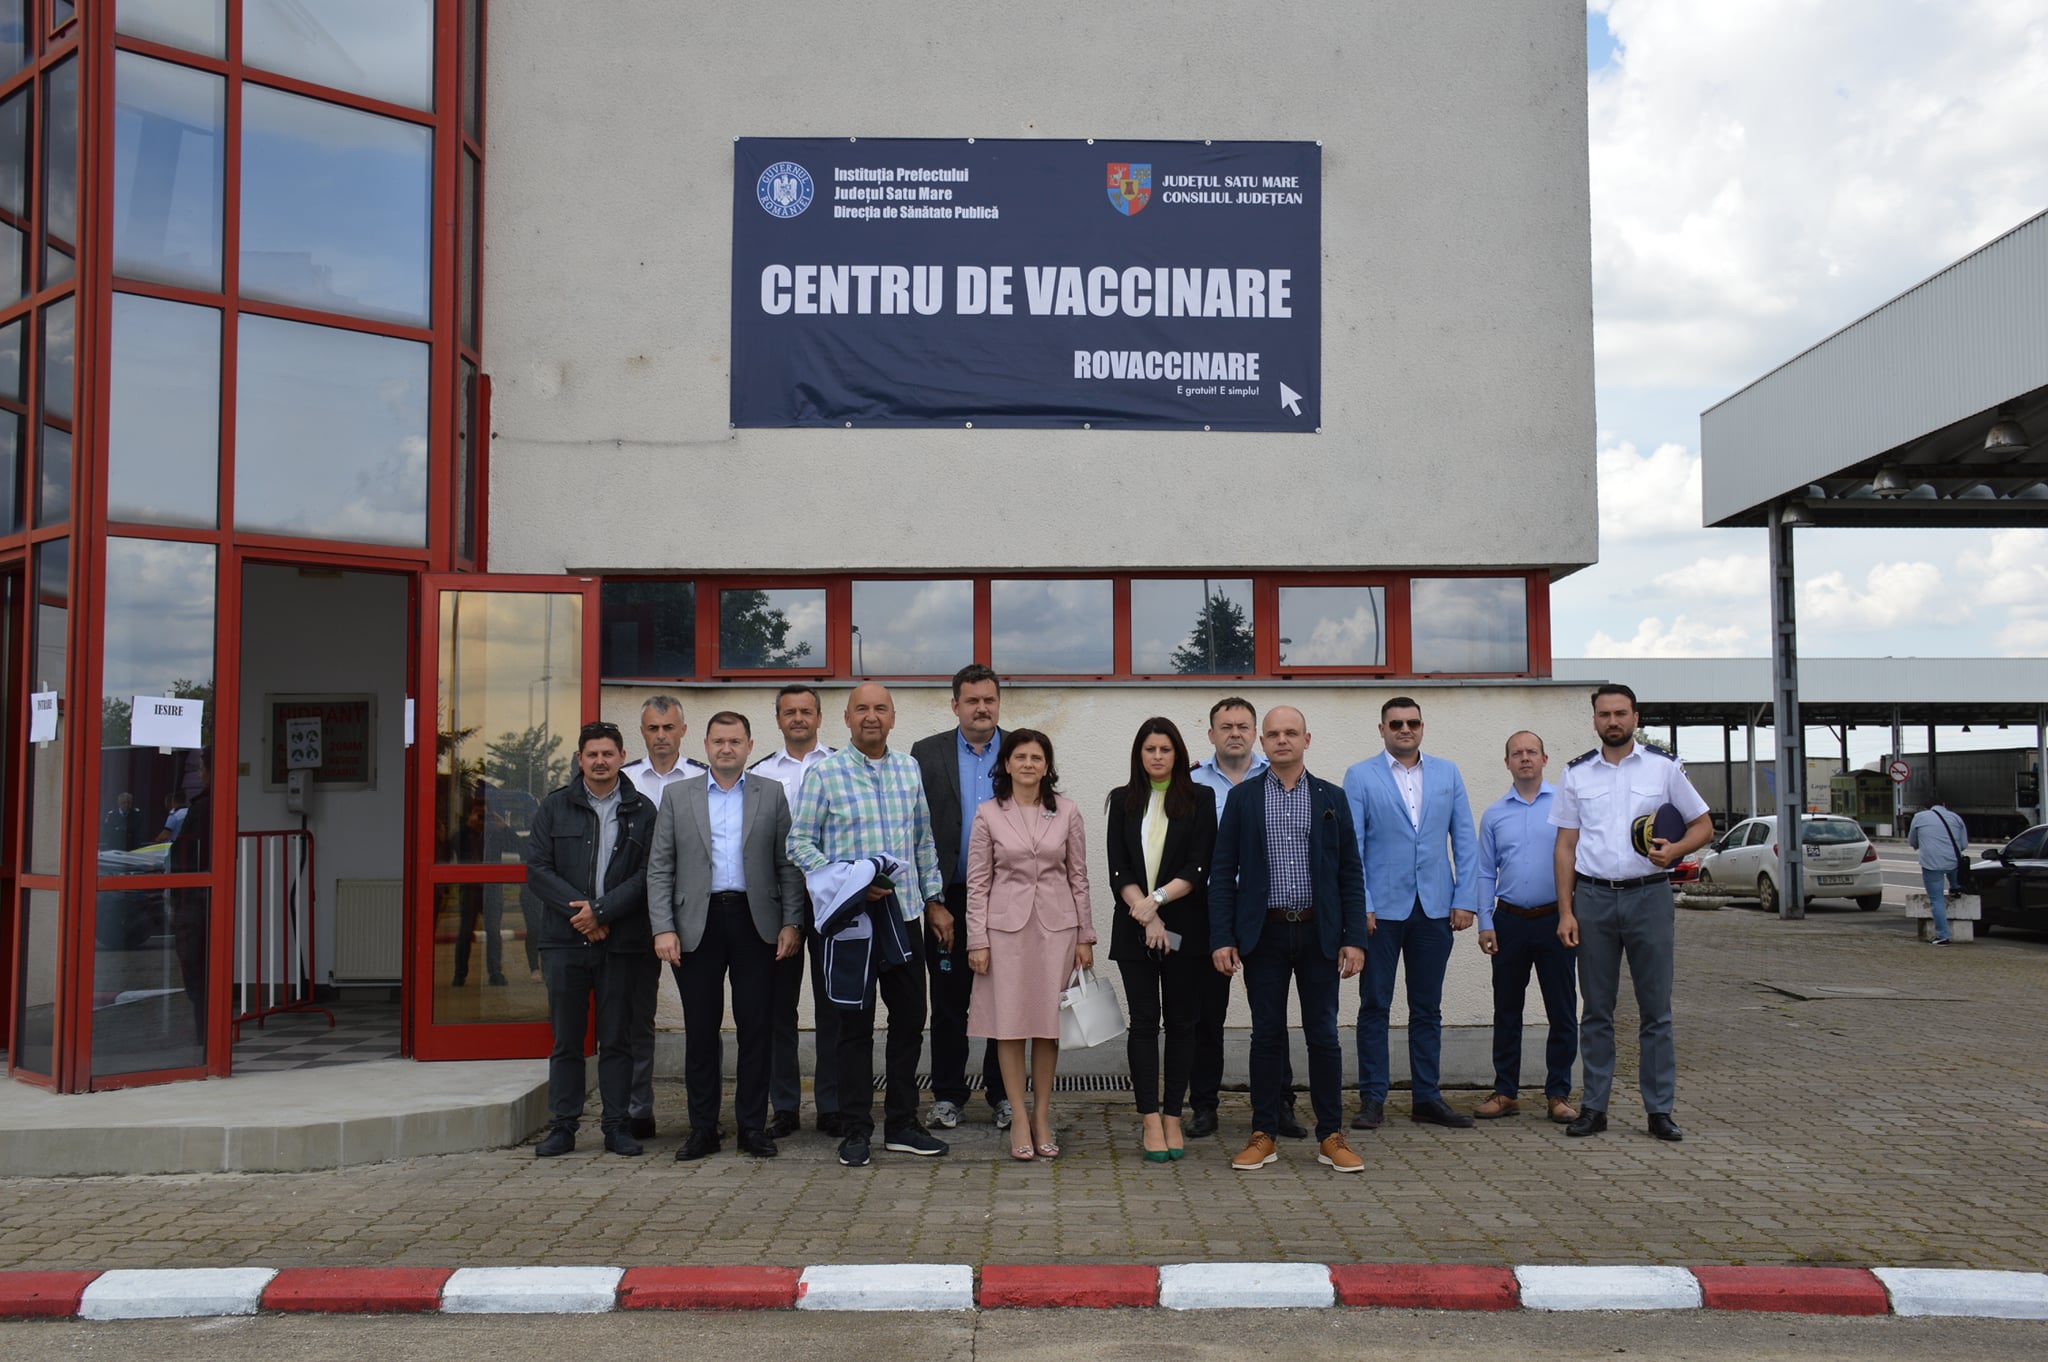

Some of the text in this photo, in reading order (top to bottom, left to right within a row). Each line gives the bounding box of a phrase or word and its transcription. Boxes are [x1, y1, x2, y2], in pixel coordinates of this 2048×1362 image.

[762, 164, 809, 184] GUVERNUL
[835, 168, 968, 184] Instituția Prefectului
[1162, 175, 1299, 189] JUDEȚUL SATU MARE
[834, 187, 952, 203] Județul Satu Mare
[1163, 192, 1302, 206] CONSILIUL JUDEȚEAN
[834, 205, 999, 221] Direcția de Sănătate Publică
[761, 264, 1291, 318] CENTRU DE VACCINARE
[1074, 350, 1259, 380] ROVACCINARE
[1177, 386, 1259, 397] E gratuit! E simplu!
